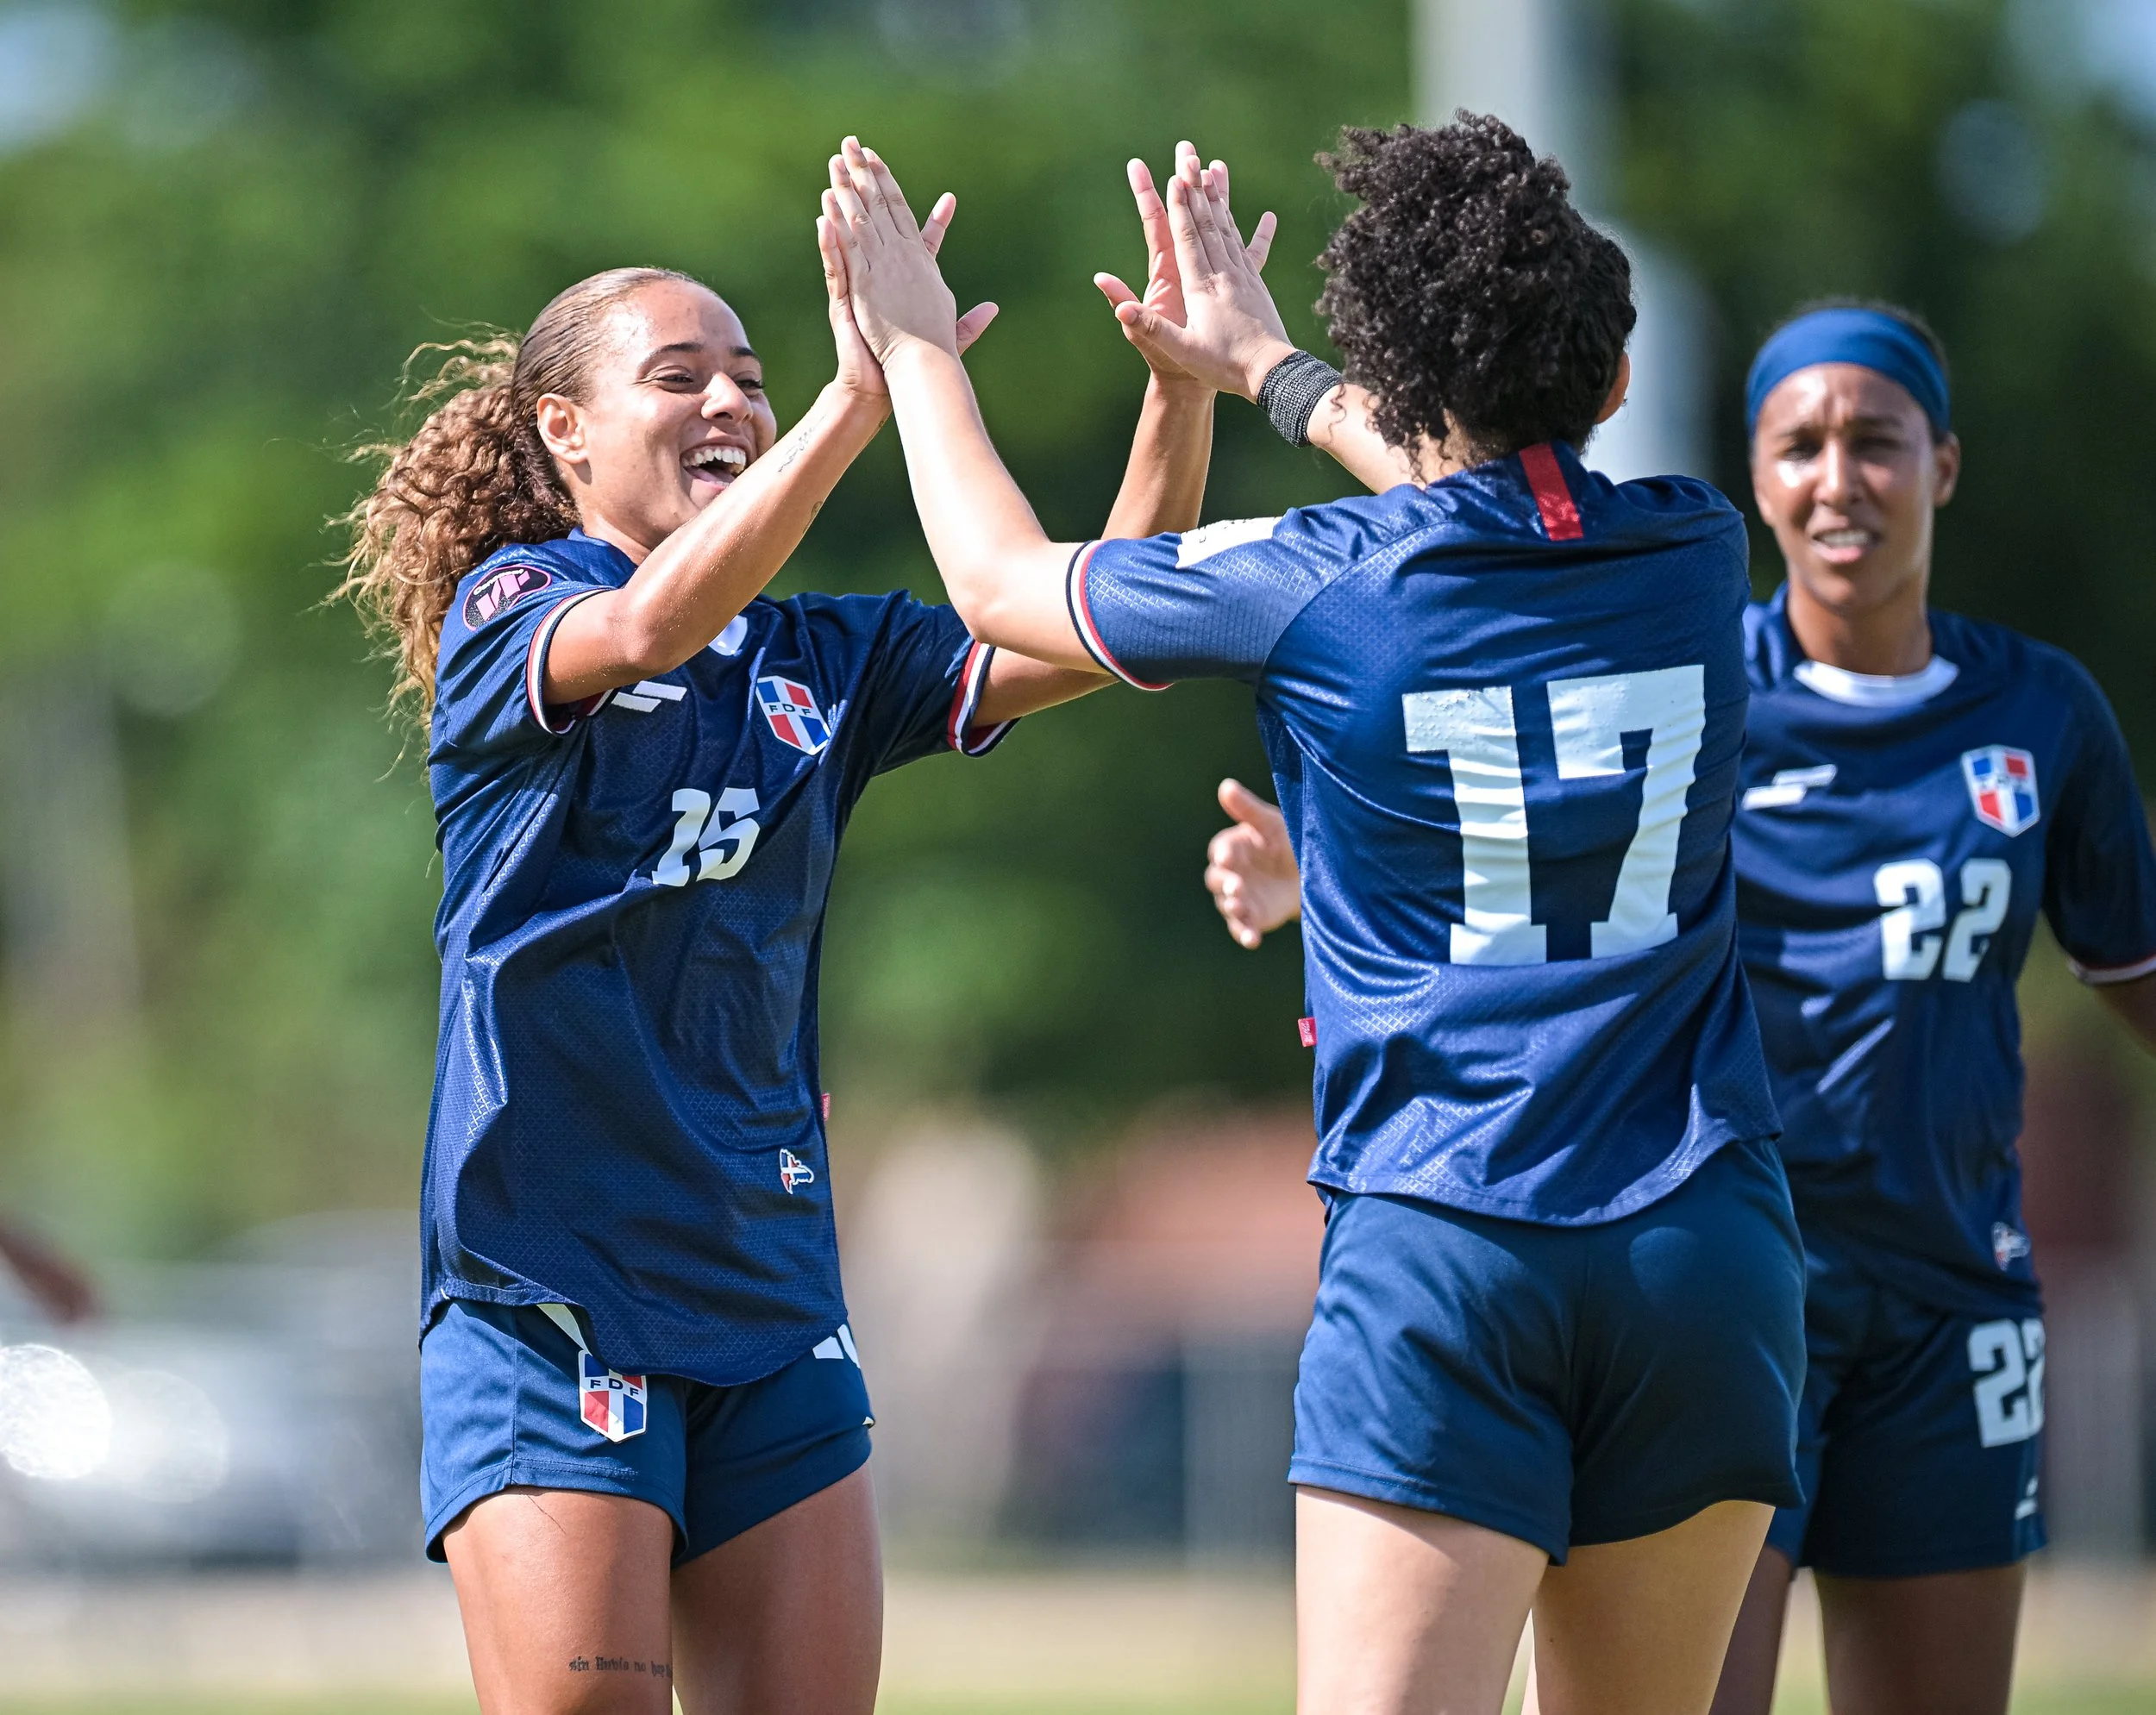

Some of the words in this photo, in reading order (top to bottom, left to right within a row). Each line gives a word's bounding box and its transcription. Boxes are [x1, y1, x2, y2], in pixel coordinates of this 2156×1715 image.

[768, 703, 812, 716] FDF
[651, 786, 761, 887] 15
[1402, 664, 1707, 966] 17
[1873, 858, 2013, 983] 22
[590, 1377, 639, 1397] FDF
